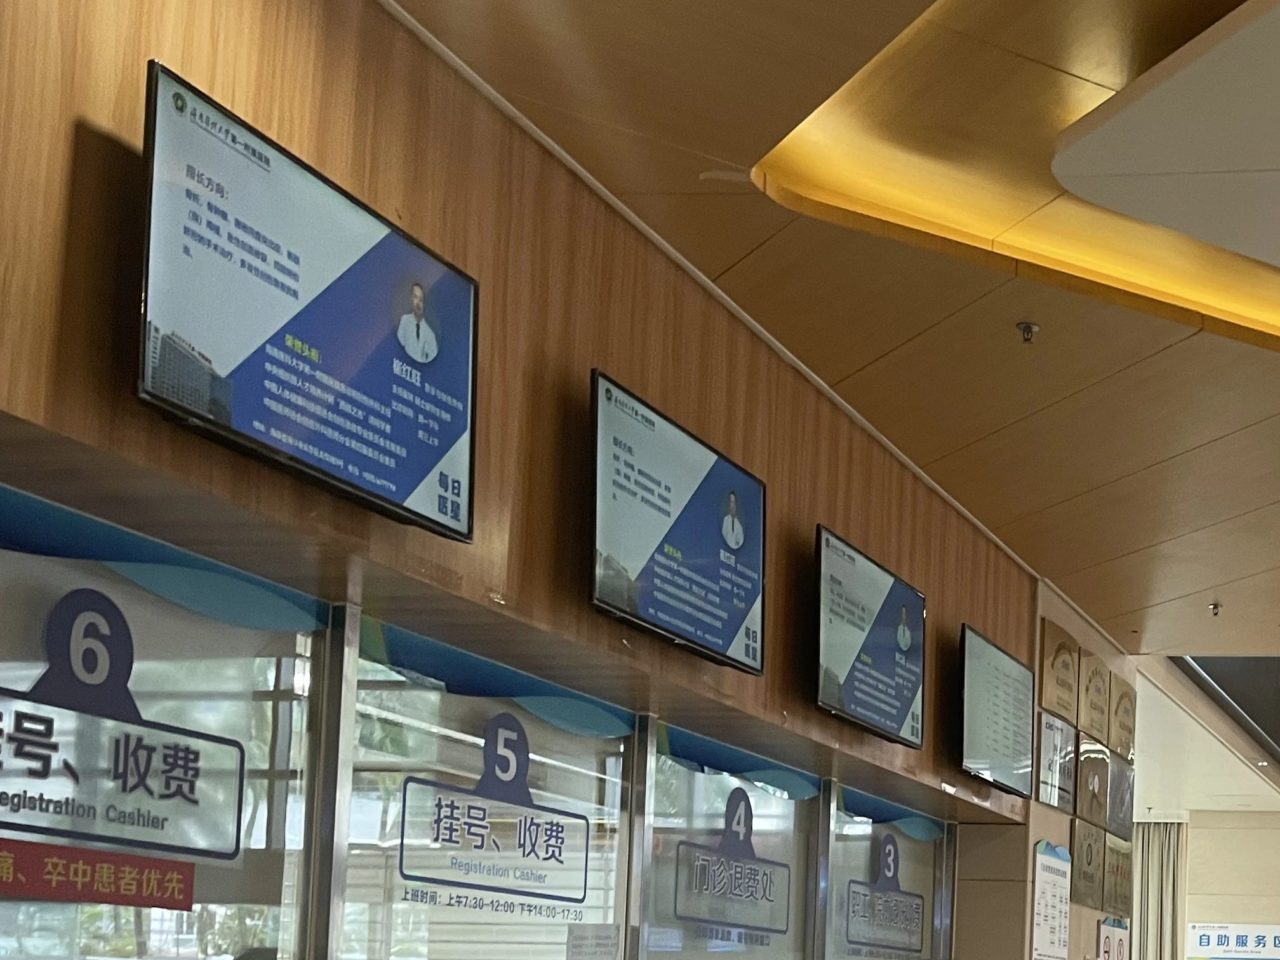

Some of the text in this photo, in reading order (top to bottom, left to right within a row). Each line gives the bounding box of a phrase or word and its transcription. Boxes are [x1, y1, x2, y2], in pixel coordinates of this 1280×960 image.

[438, 471, 461, 498] 每日
[69, 610, 111, 686] 6
[0, 710, 201, 806] 号、收费
[495, 727, 519, 782] 5
[0, 790, 168, 831] egistration Cashier
[432, 797, 566, 865] 挂号、收费
[731, 801, 746, 841] 4
[450, 856, 548, 884] Registration Cashier
[693, 854, 775, 903] 门诊退费处
[884, 843, 895, 878] 3
